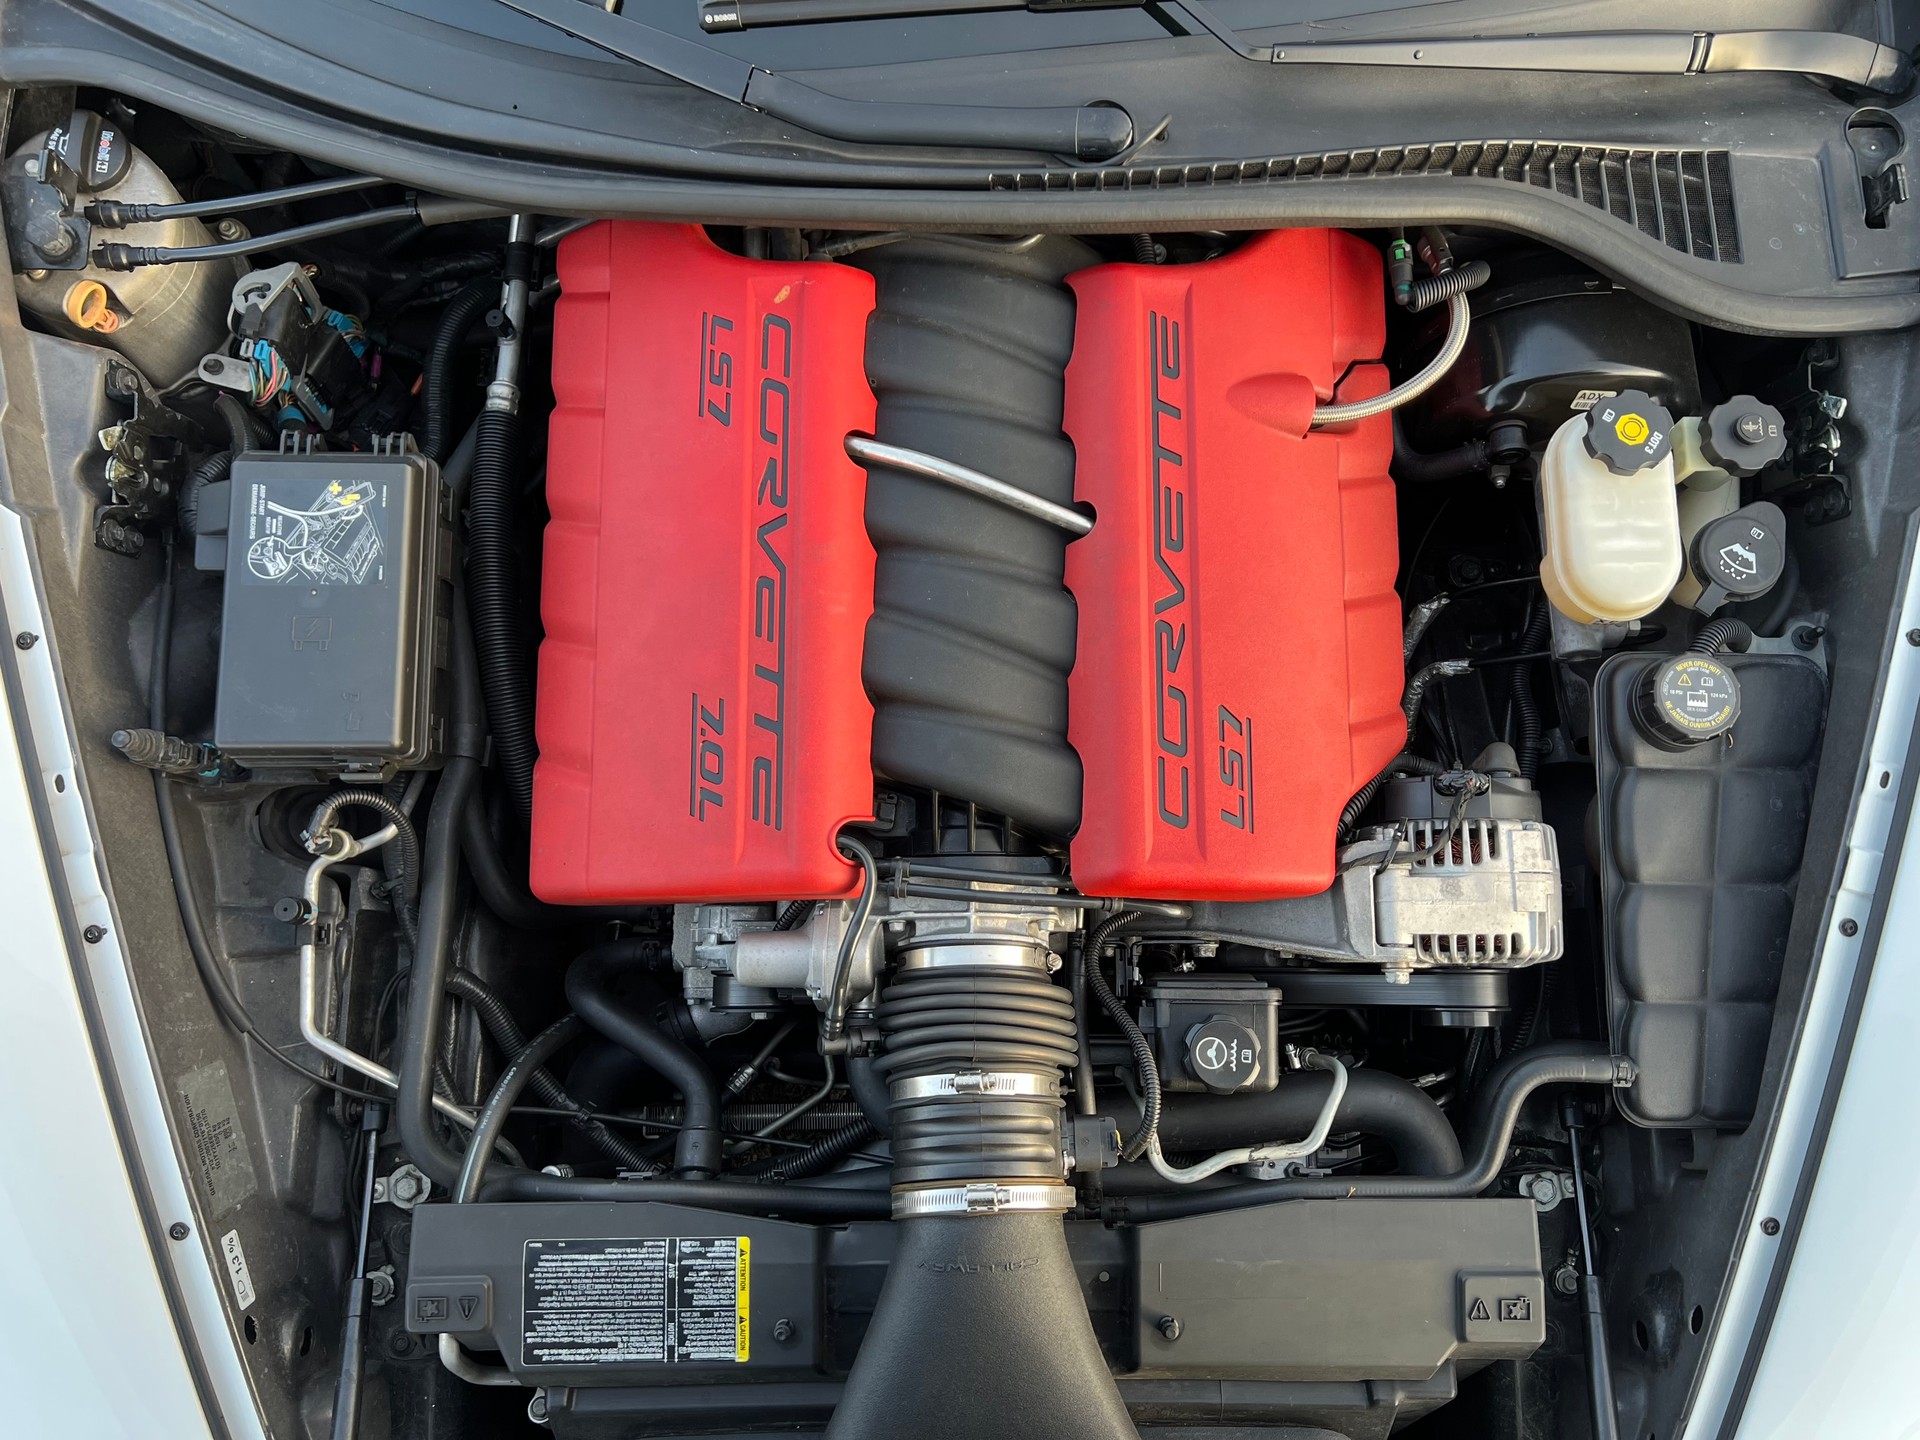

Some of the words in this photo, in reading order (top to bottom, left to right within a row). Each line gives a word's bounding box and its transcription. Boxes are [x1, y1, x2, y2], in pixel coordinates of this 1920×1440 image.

[50, 127, 63, 141] SAE
[97, 130, 114, 161] Mobil
[707, 314, 734, 427] LS7
[1644, 446, 1654, 455] 3
[1648, 431, 1664, 450] DOT
[752, 312, 791, 831] CORVETTE
[1150, 310, 1189, 830] CORVETTE
[1675, 661, 1693, 672] NEVER
[1693, 660, 1708, 669] OPEN
[1709, 664, 1722, 676] HOT!
[1665, 700, 1673, 710] NE
[1670, 709, 1689, 726] JAMAIS
[1689, 721, 1711, 729] OUVRIR
[1715, 705, 1732, 723] CHAUD!
[699, 697, 725, 822] 7.0L
[1218, 704, 1245, 830] LS7
[491, 1067, 517, 1106] GOODYEAR
[184, 1094, 200, 1139] CORPORATION
[196, 1139, 208, 1167] MOTORS
[204, 1167, 216, 1196] GENERAL
[227, 1237, 236, 1254] %
[231, 1255, 242, 1275] 1,3
